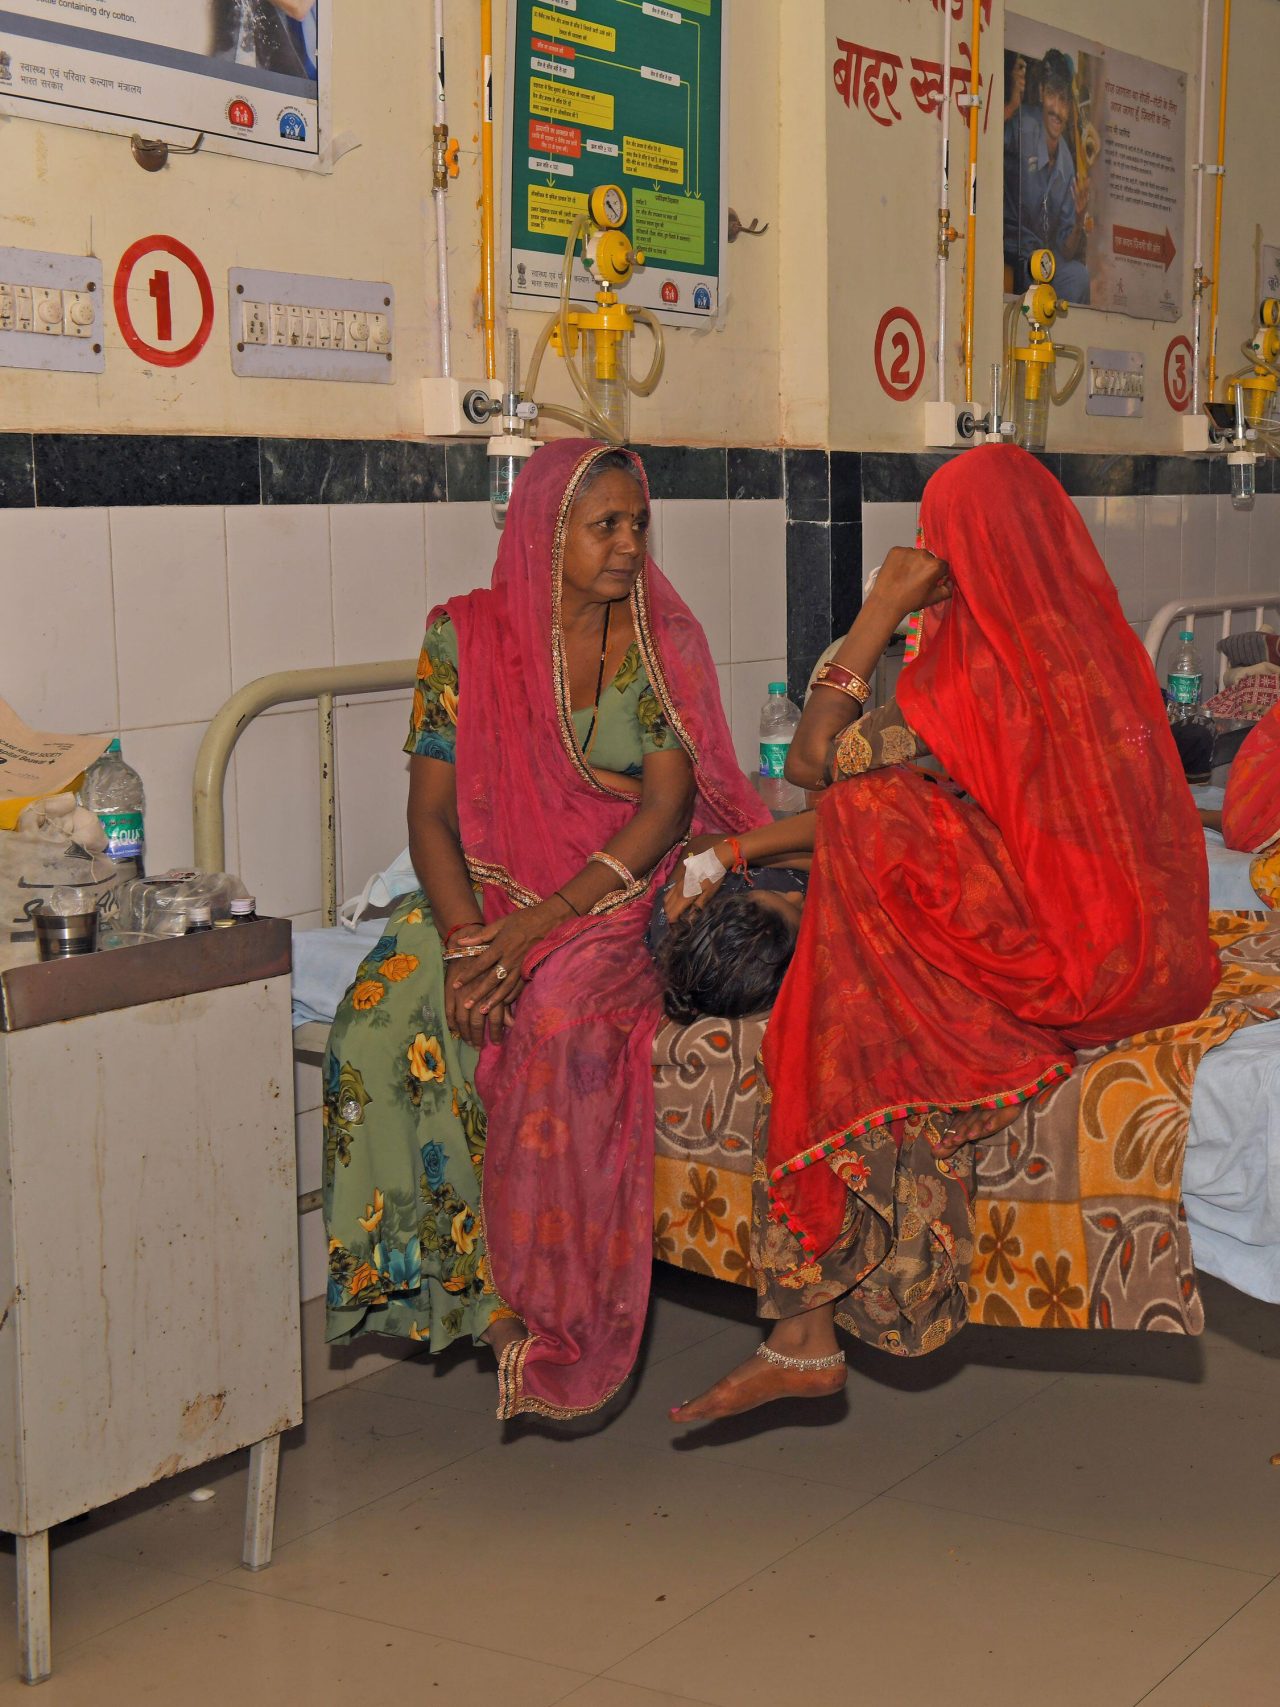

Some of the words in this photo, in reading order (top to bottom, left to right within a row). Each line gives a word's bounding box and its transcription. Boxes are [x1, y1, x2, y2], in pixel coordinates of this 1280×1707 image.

[58, 0, 97, 15] containing
[99, 7, 111, 19] dry
[112, 11, 137, 23] cotton.
[20, 75, 38, 87] भारत
[41, 79, 64, 91] सरकार
[833, 36, 904, 127] बाहर
[149, 269, 172, 341] 1
[891, 331, 910, 384] 2
[1173, 354, 1187, 400] 3
